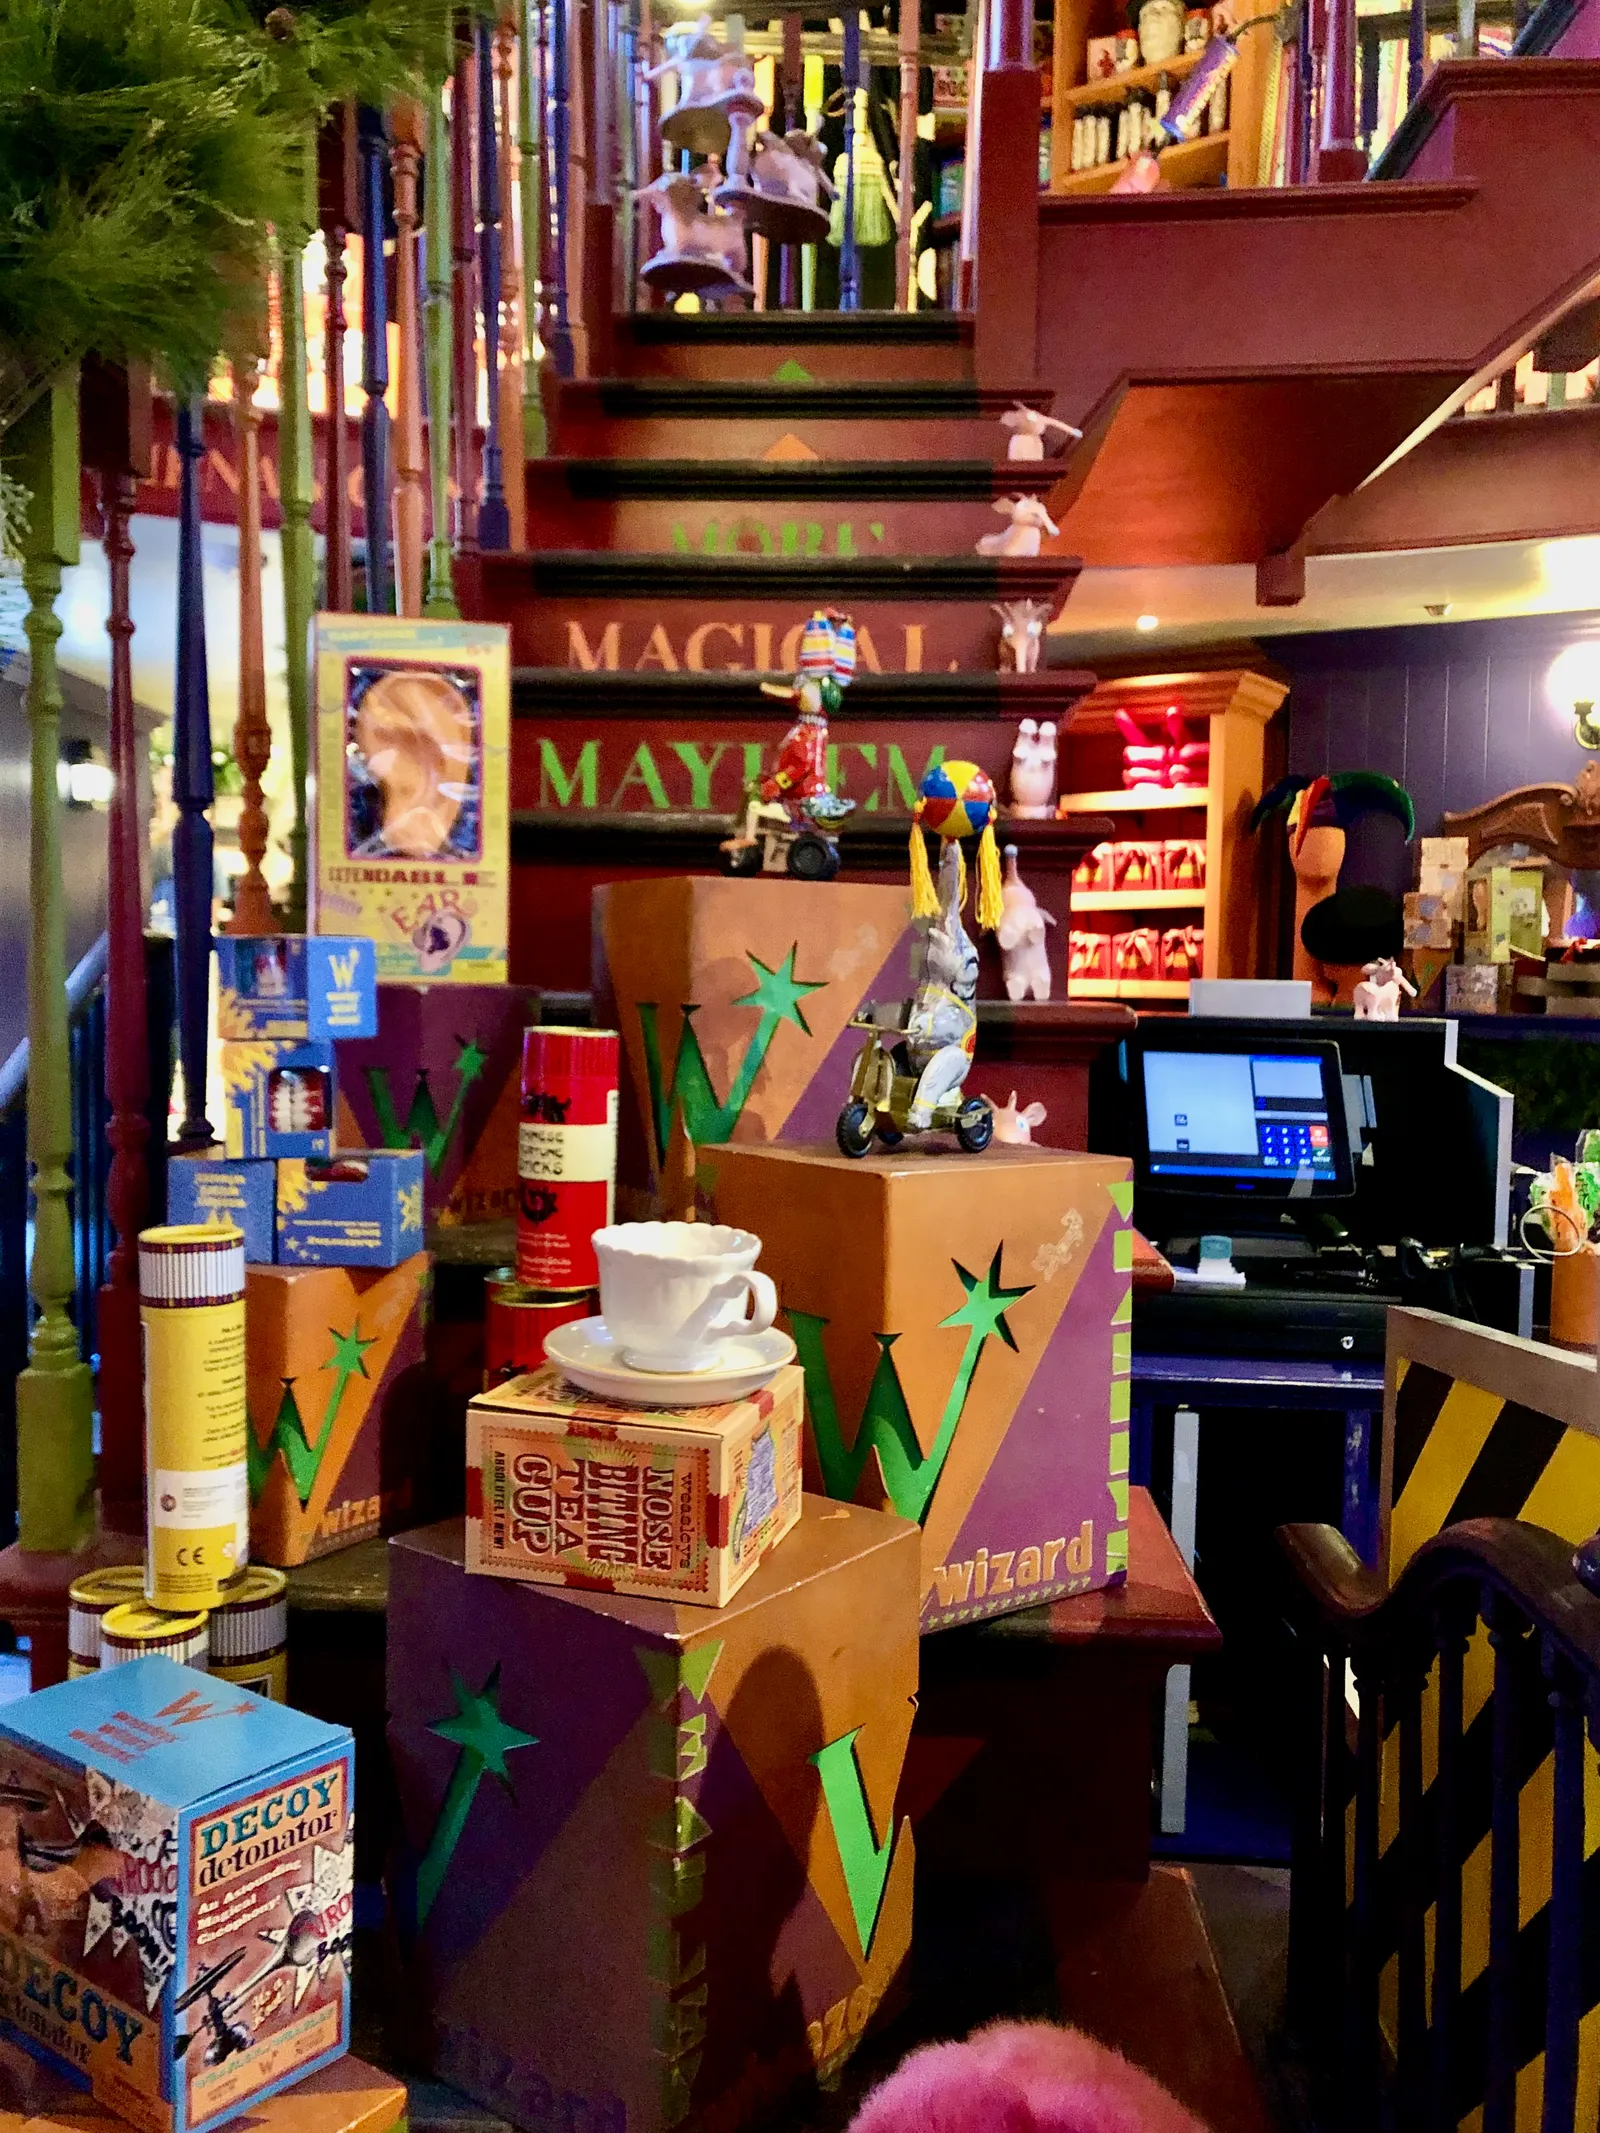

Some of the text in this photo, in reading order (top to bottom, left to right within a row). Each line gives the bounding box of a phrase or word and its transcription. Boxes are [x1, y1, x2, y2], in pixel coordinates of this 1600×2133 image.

[493, 1450, 506, 1519] ABSOLUTELY
[511, 1453, 553, 1555] CUP
[555, 1457, 585, 1556] TEA
[585, 1460, 640, 1564] BITING
[641, 1465, 675, 1571] NOSE
[933, 1519, 1093, 1608] wizard
[199, 1772, 339, 1860] DECOY
[199, 1809, 338, 1888] detonator
[197, 1893, 257, 1931] Magical
[198, 1900, 220, 1916] An
